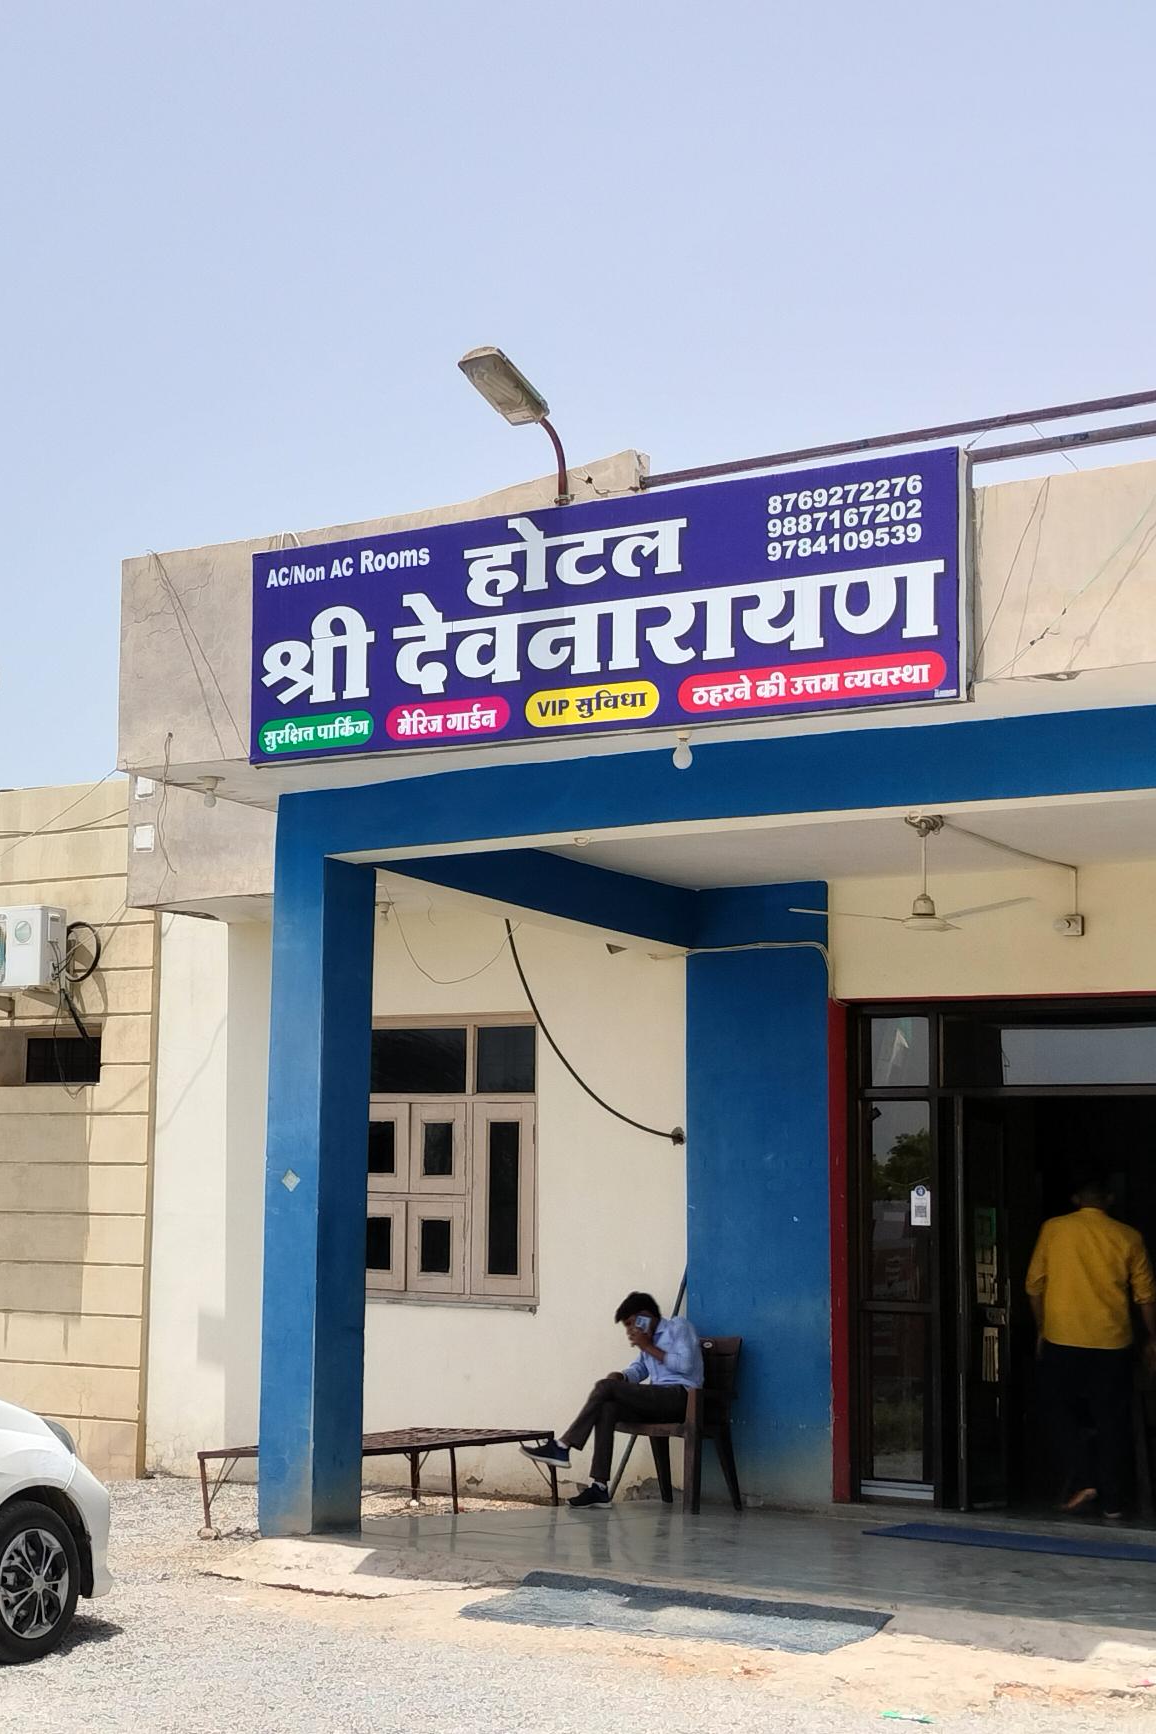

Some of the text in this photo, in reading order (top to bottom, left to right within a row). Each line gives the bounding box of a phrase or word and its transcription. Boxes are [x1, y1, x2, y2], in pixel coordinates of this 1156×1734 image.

[767, 474, 923, 515] 8769272276
[767, 498, 923, 538] 9887167202
[463, 516, 688, 607] होटल
[767, 522, 923, 562] 9784109539
[265, 547, 431, 589] AC/Non AC Rooms
[260, 558, 945, 705] श्री देवनारायण
[537, 689, 649, 719] VIP सुविधा
[691, 663, 932, 708] ठहरने की उत्तम व्यवस्था
[263, 715, 370, 752] सुरक्षित पार्किंग
[396, 703, 497, 737] मेरिज गार्डन
